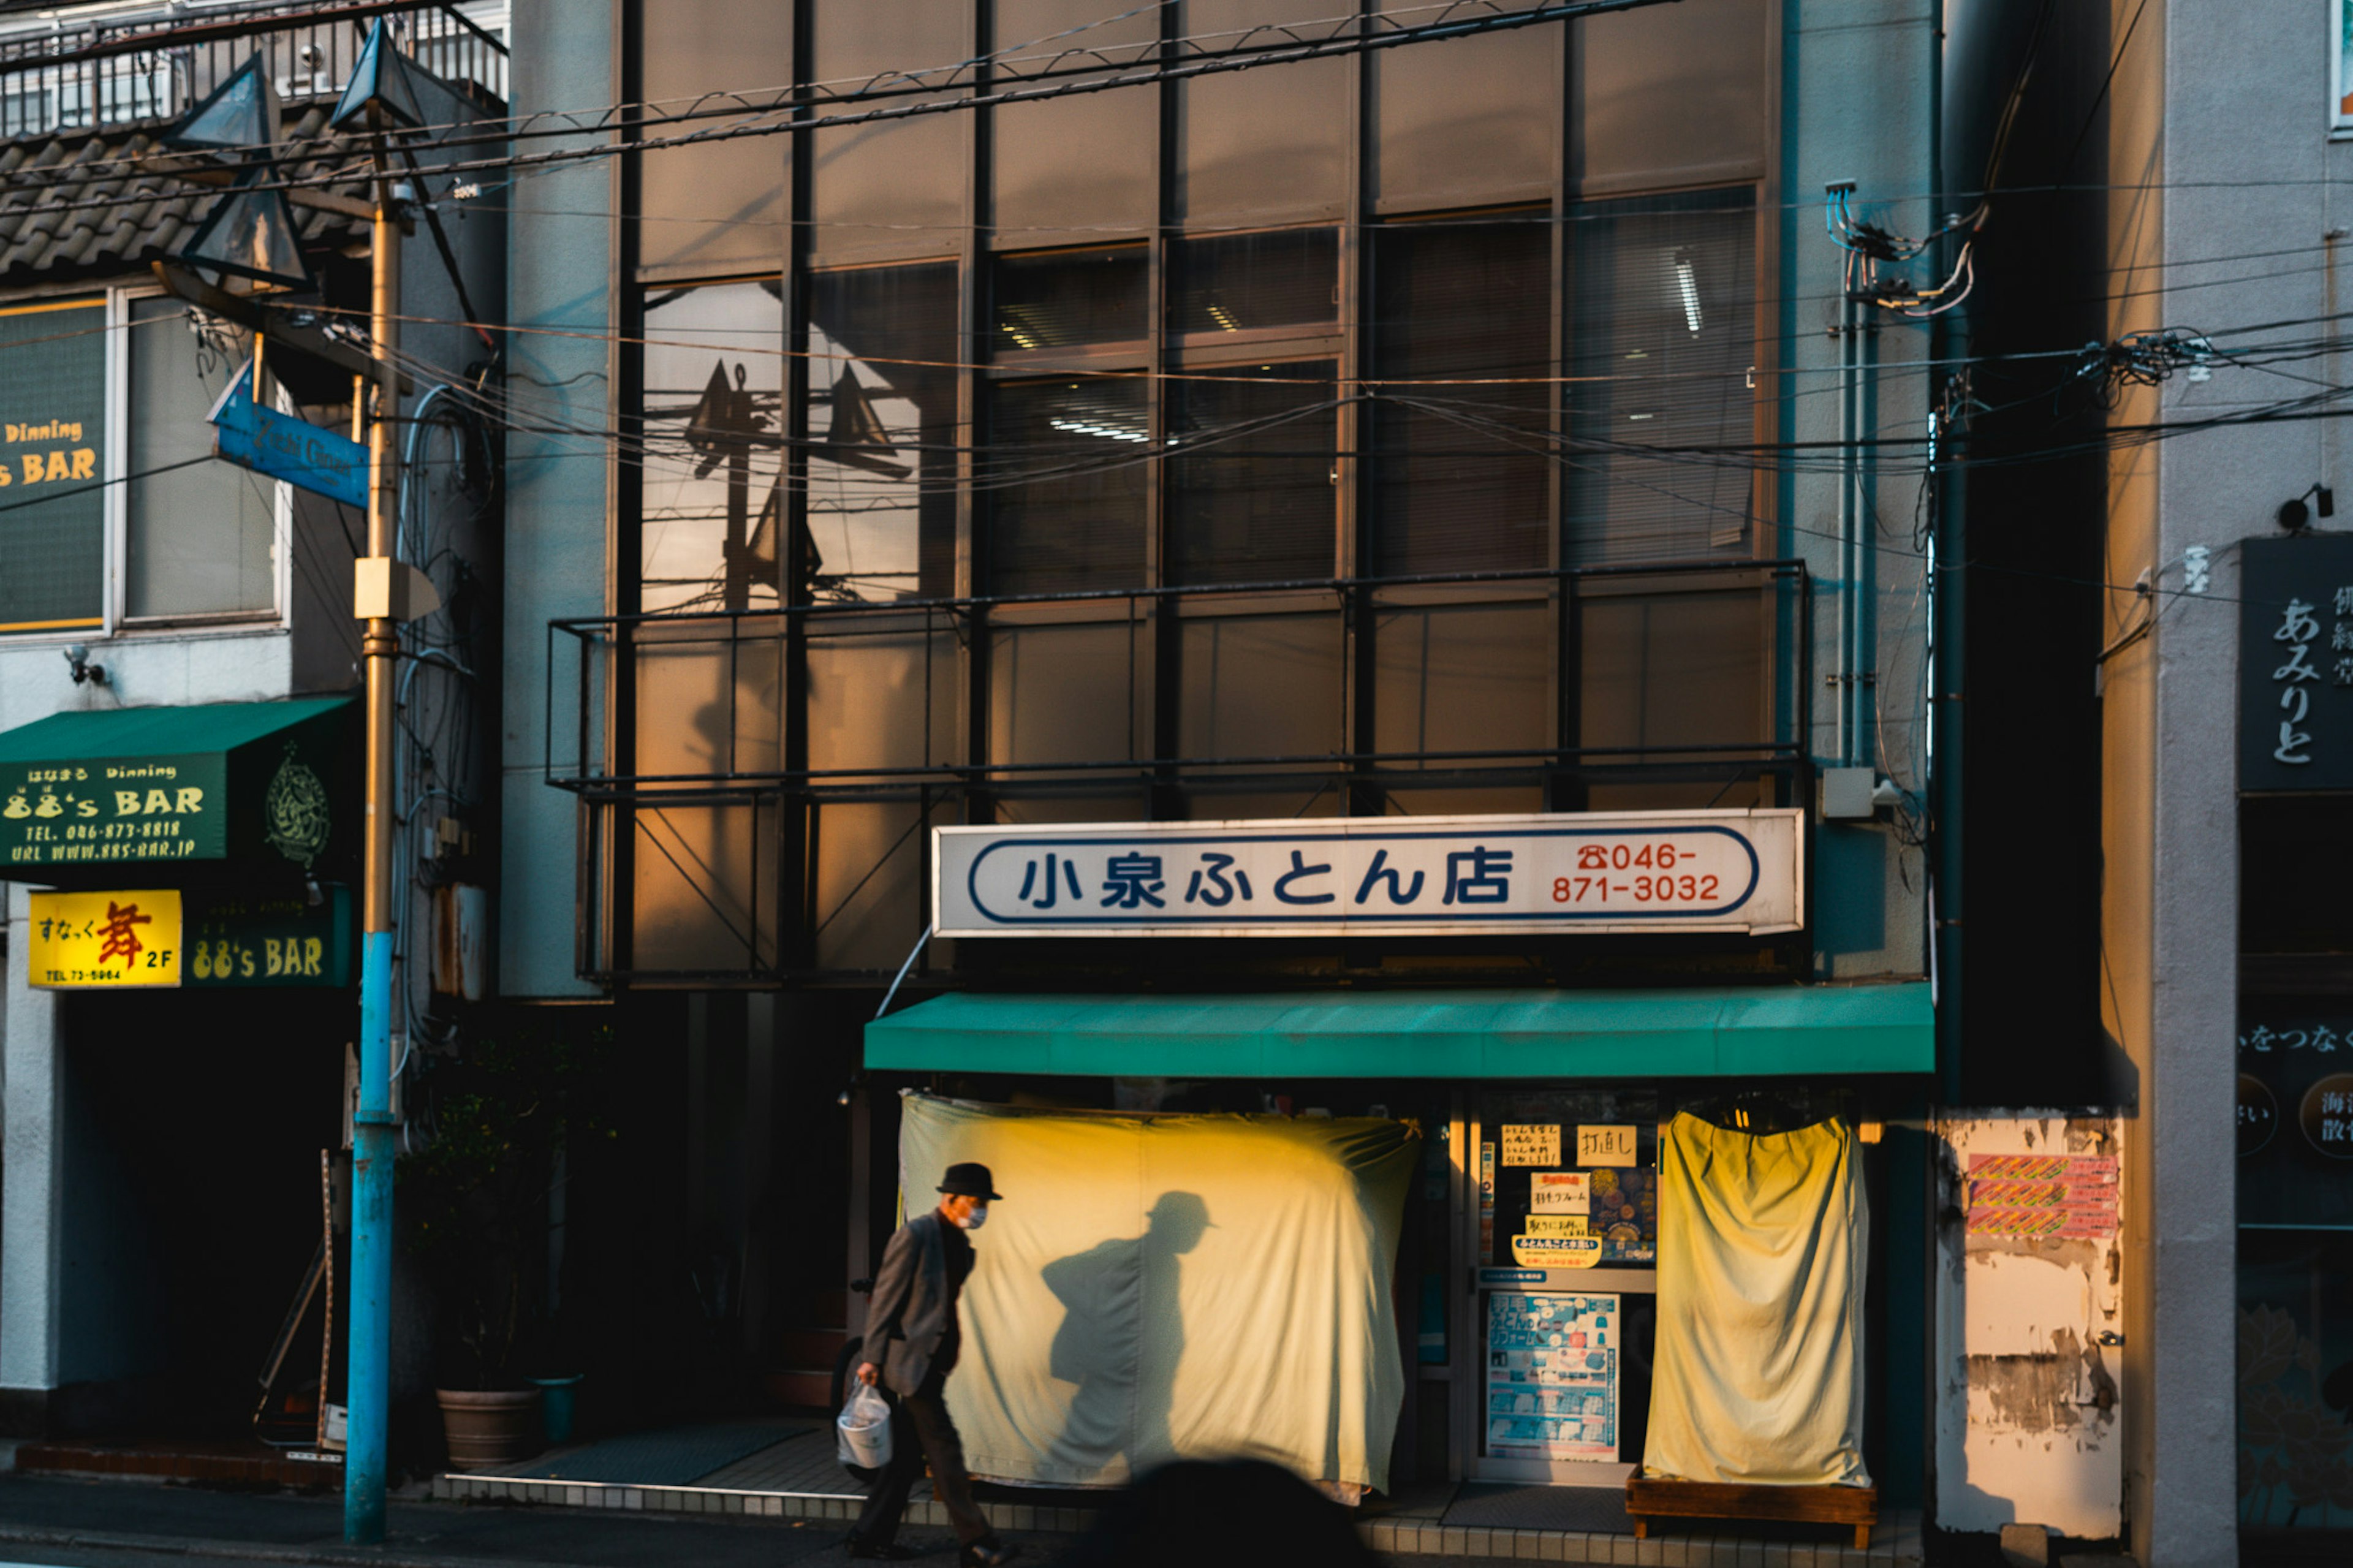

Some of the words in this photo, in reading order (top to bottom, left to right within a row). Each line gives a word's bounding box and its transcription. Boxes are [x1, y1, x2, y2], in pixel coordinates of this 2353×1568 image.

[5, 419, 82, 443] Dinning
[21, 448, 96, 485] BAR
[2273, 598, 2321, 763] あみりと
[106, 765, 176, 779] Dinning
[115, 787, 203, 817] BAR
[26, 827, 58, 841] TEL.
[12, 846, 40, 861] URL
[1612, 843, 1696, 870] 046-
[1018, 846, 1514, 909] 小泉ふとん店
[1553, 874, 1718, 903] 871-3032
[39, 917, 94, 942] すなっく
[97, 900, 152, 971] 舞
[147, 950, 172, 968] 2F
[264, 937, 322, 978] BAR
[1582, 1131, 1632, 1156] 打直し
